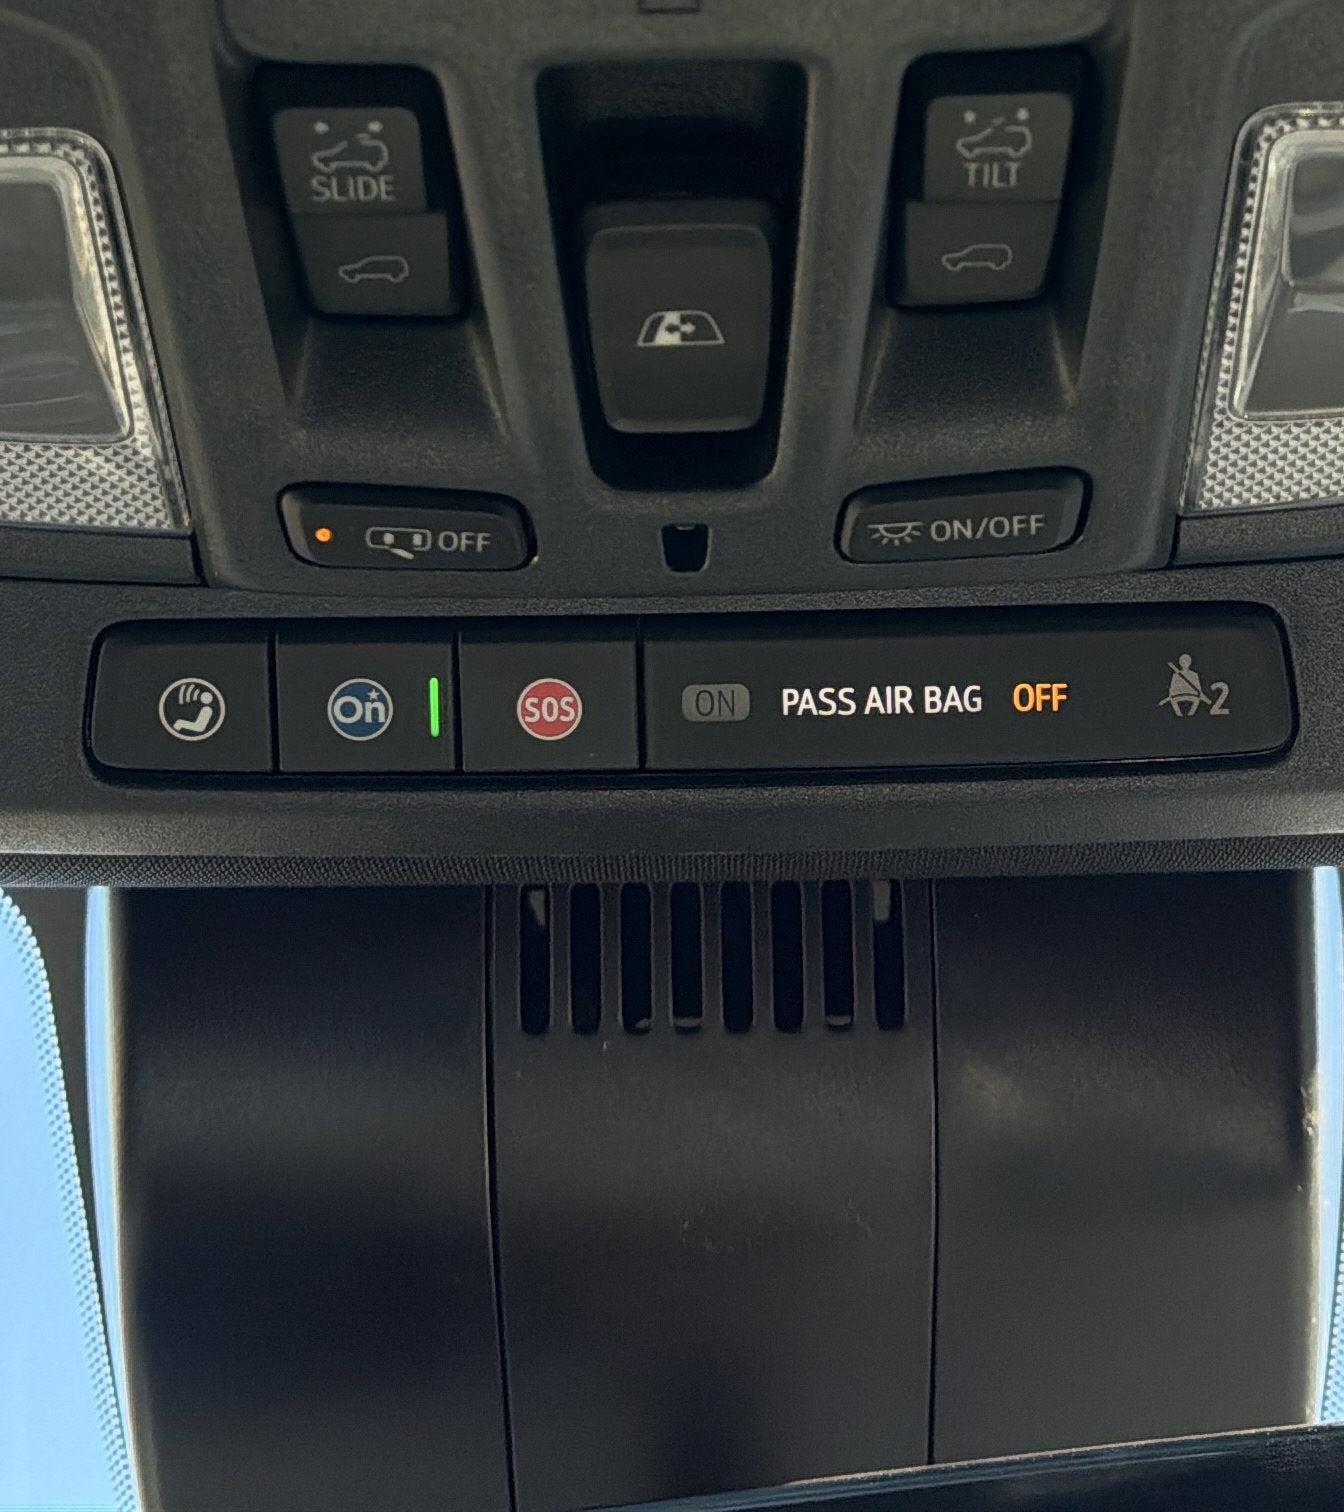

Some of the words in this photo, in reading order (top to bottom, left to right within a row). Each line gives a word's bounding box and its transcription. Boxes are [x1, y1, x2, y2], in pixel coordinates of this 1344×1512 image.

[311, 174, 396, 202] SLIDE
[964, 160, 1022, 188] TILT
[437, 530, 492, 553] OFF
[929, 513, 1046, 542] ON/OFF
[524, 696, 575, 724] SOS
[694, 689, 737, 716] ON
[781, 687, 857, 716] PASS
[864, 685, 914, 715] AIR
[924, 684, 984, 714] BAG
[1012, 682, 1069, 713] OFF
[1209, 680, 1231, 716] 2
